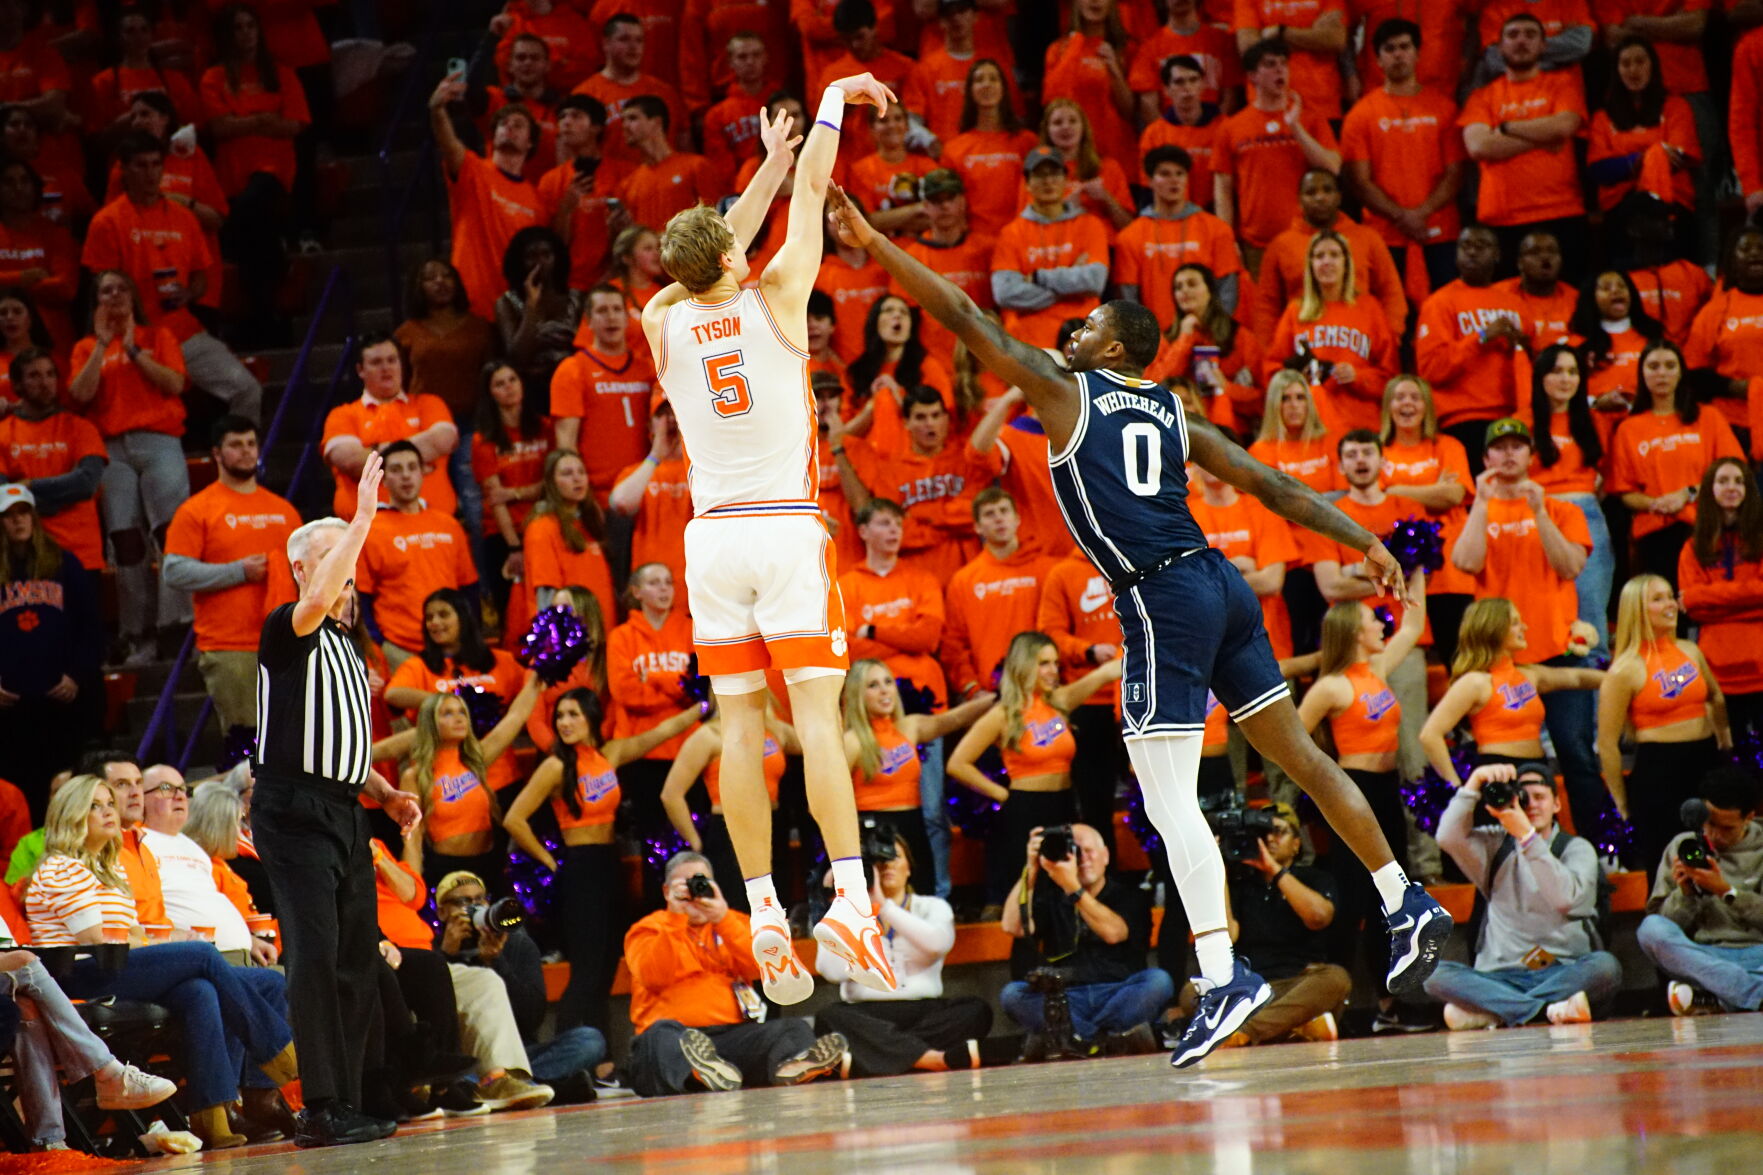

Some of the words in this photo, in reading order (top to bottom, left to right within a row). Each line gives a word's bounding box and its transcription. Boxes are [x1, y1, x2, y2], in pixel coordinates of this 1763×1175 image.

[691, 316, 741, 344] TYSON
[702, 349, 754, 419] 5
[622, 396, 635, 428] 1
[1092, 390, 1175, 429] WHITEHEAD
[1121, 422, 1162, 497] 0
